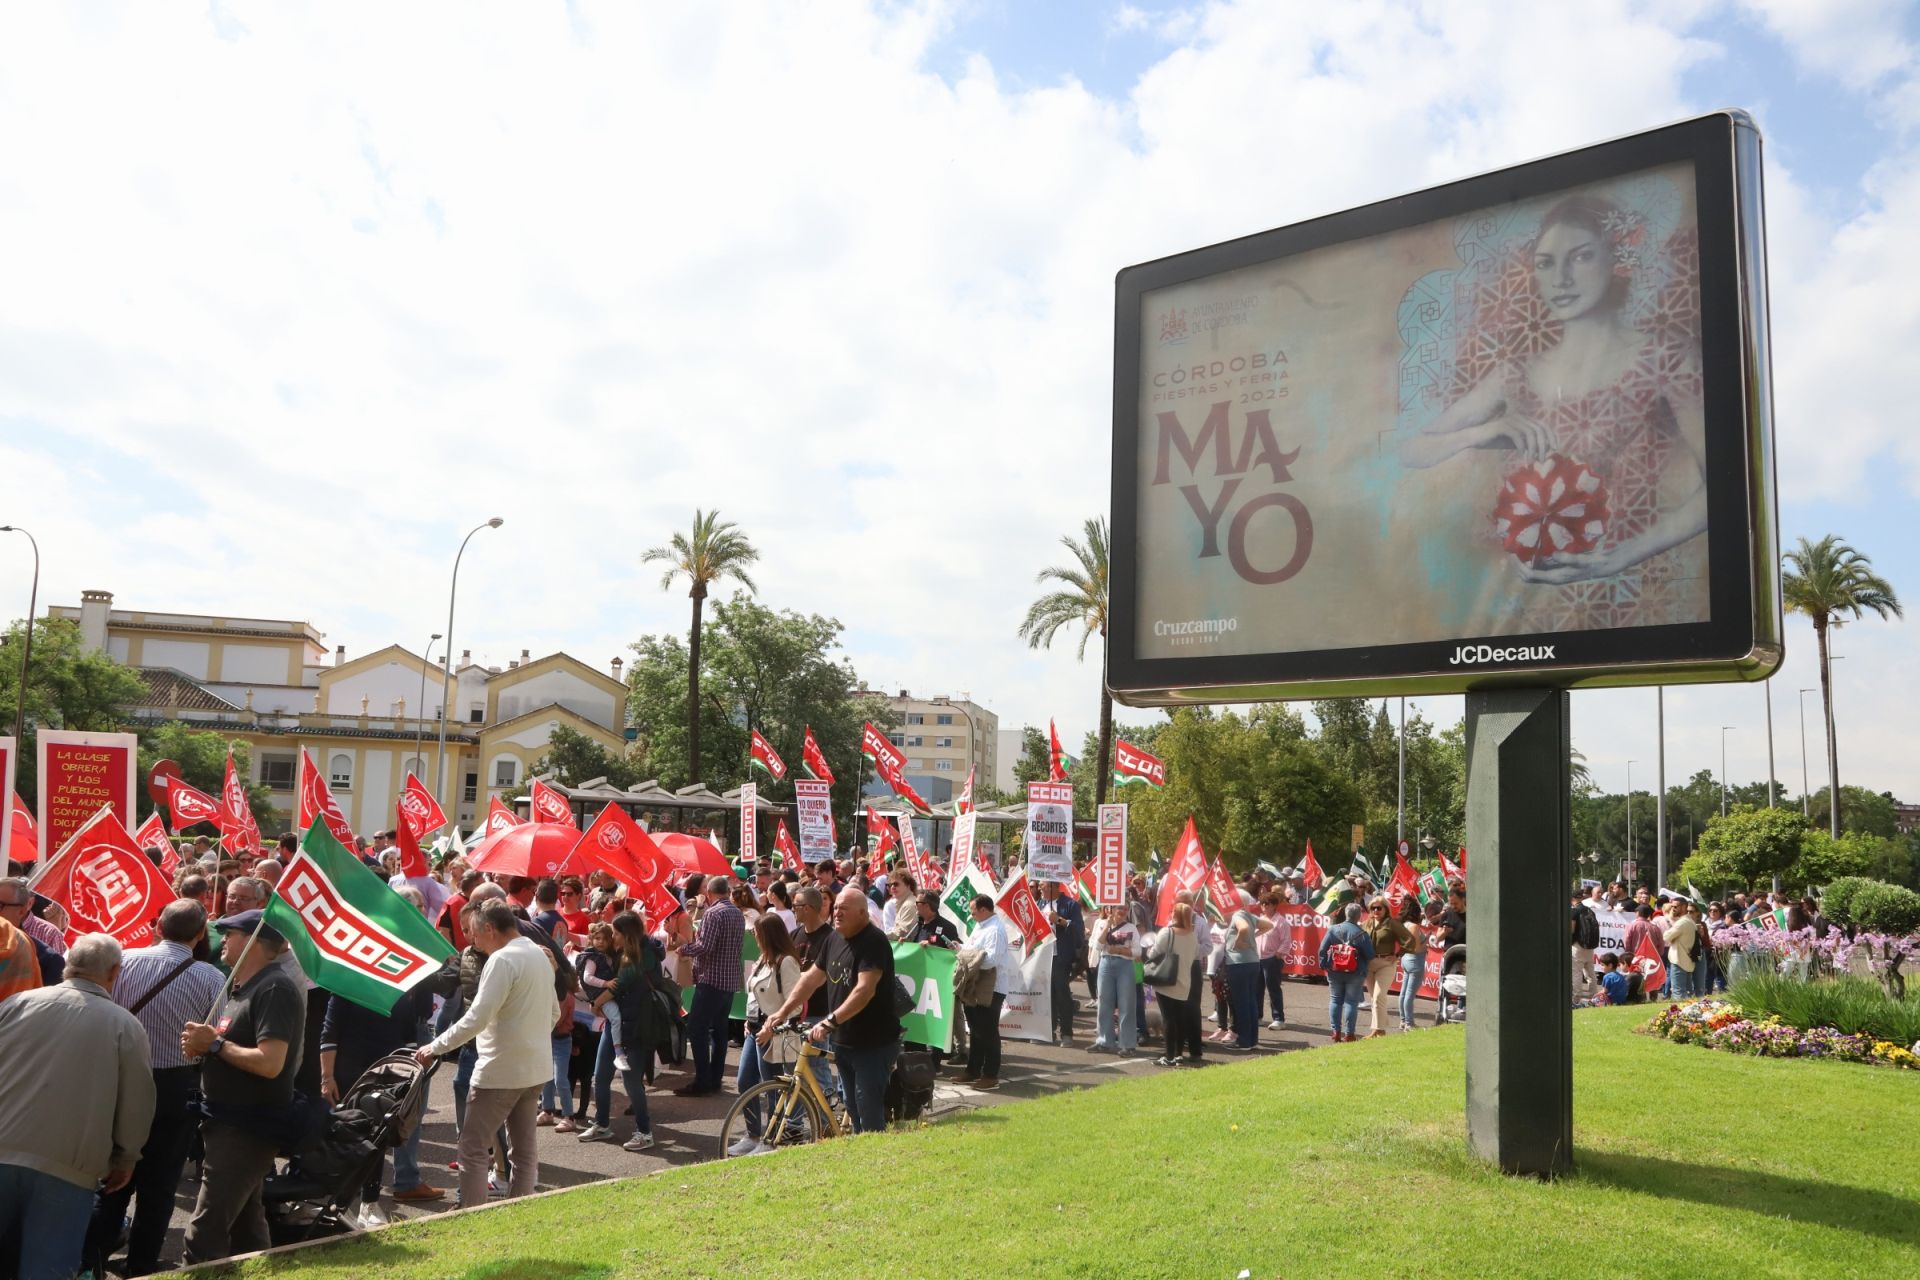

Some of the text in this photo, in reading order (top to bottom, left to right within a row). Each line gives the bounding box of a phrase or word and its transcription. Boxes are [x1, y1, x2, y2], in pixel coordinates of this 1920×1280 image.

[1153, 350, 1289, 388] CÓRDOBA
[1153, 370, 1289, 402] FIESTAS Y FERIA
[1240, 387, 1289, 404] 2025
[1152, 400, 1301, 486] MA
[1178, 478, 1314, 585] YO
[1154, 618, 1237, 636] Cruzcampo
[1449, 645, 1556, 665] JCDecaux
[57, 751, 111, 762] LA CLASE
[865, 730, 900, 768] CCOO
[61, 763, 107, 774] OBRERA
[1118, 748, 1164, 779] CCOO
[67, 774, 101, 784] Y LOS
[58, 785, 110, 796] PUEBLOS
[1030, 786, 1071, 801] CCOO
[53, 796, 116, 808] DEL MUNDO
[806, 800, 827, 810] QUIERO
[744, 807, 753, 857] CCOO
[1031, 820, 1068, 834] RECORTES
[1103, 836, 1119, 899] CCOO
[81, 851, 142, 918] UGT
[949, 890, 971, 914] PSO
[287, 871, 388, 965] CCOO
